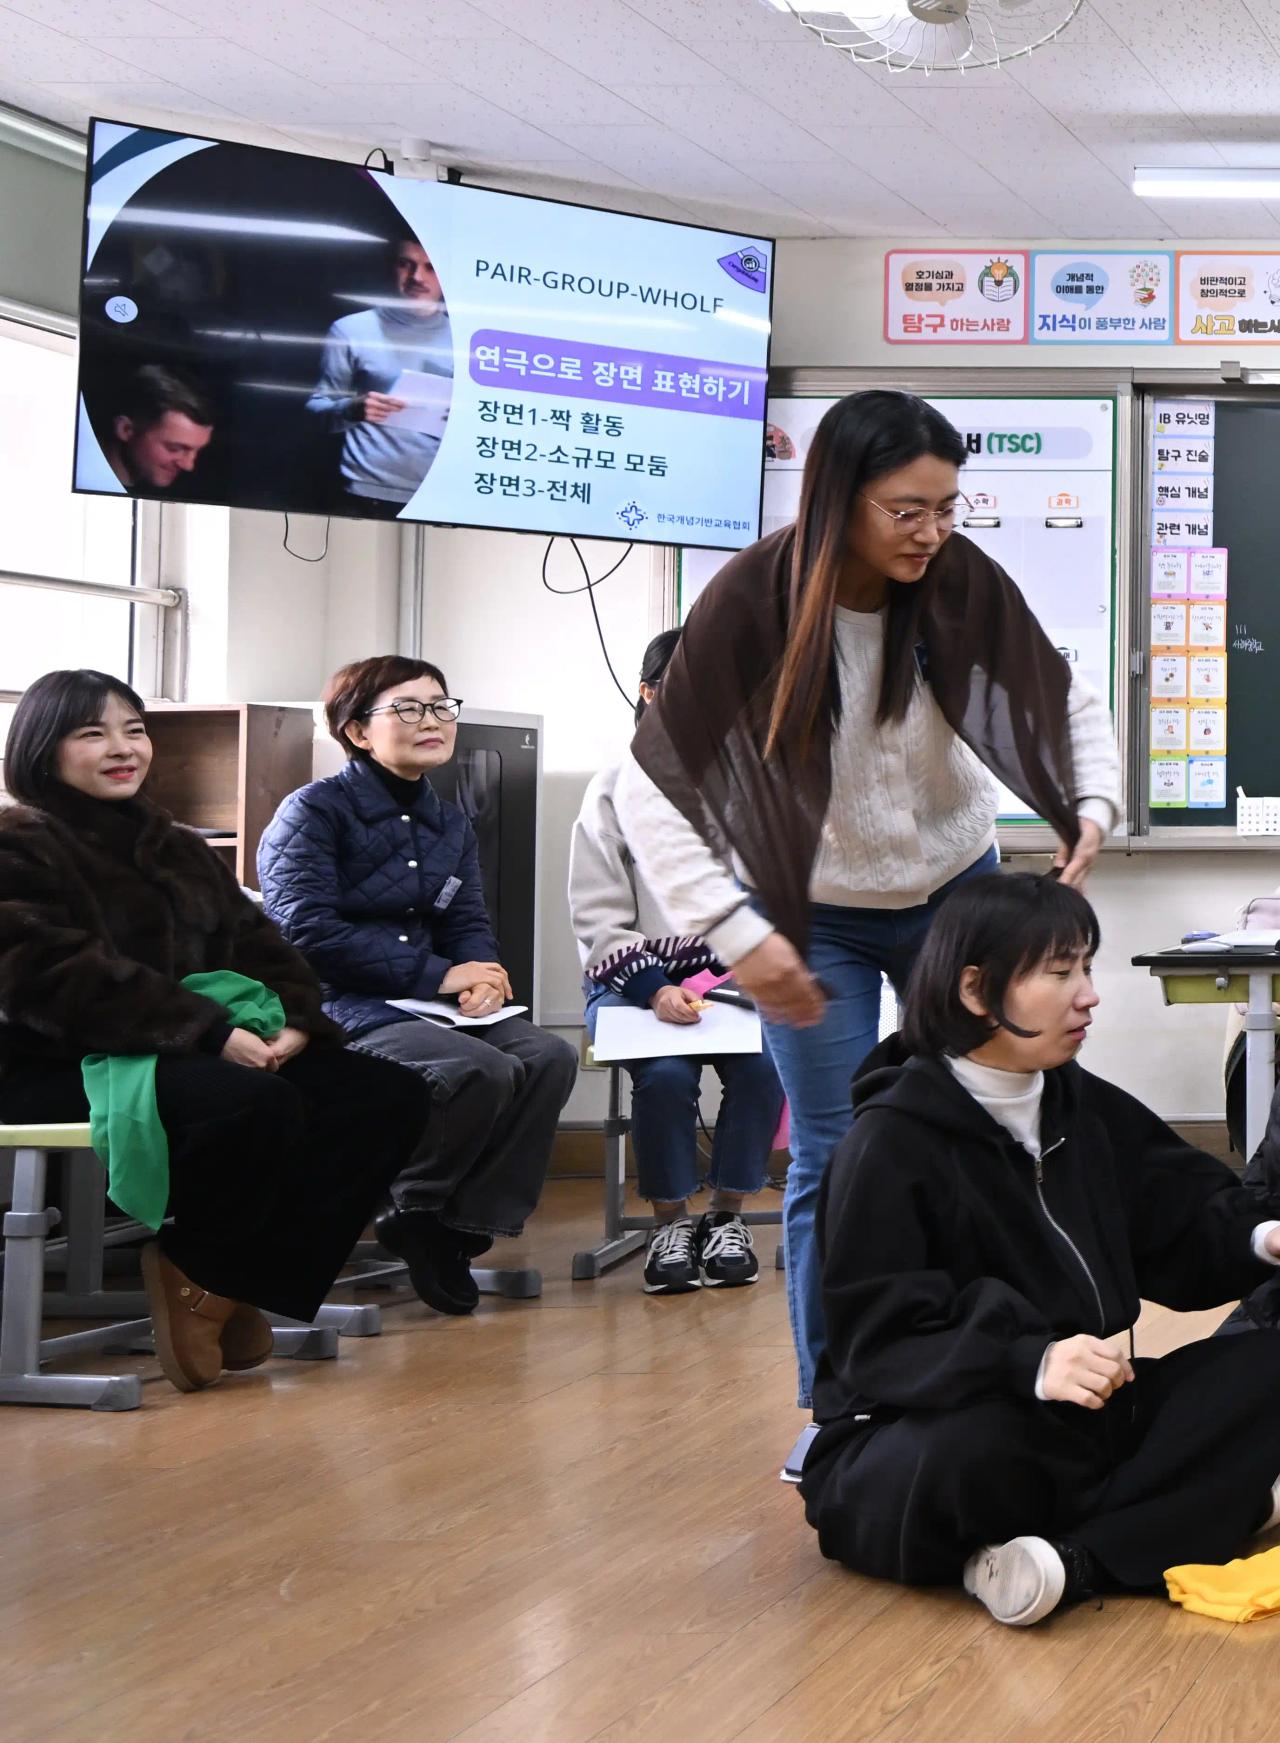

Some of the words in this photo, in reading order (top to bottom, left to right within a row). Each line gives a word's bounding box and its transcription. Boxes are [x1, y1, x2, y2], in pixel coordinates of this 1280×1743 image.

[915, 270, 954, 280] 호기심과
[1066, 273, 1094, 282] 개념적
[1200, 276, 1246, 286] 비판적이고
[904, 281, 932, 292] 열정을
[936, 281, 964, 292] 가지고
[1055, 284, 1083, 294] 이해를
[1086, 285, 1104, 294] 통한
[1200, 288, 1246, 298] 창의적으로
[902, 313, 945, 333] 탐구
[950, 317, 1011, 332] 하는사람
[1038, 313, 1091, 332] 지식이
[1095, 317, 1136, 331] 풍부한
[1141, 317, 1167, 331] 사람
[1191, 314, 1236, 335] 사고
[475, 345, 583, 381] 연극으로
[592, 360, 642, 391] 장면
[652, 369, 750, 405] 표현하기
[477, 400, 571, 432] 장면1-짝
[580, 411, 625, 438] 활동
[1159, 413, 1171, 424] IB
[1175, 413, 1210, 426] 유닛명
[987, 432, 1042, 454] (TSC)
[475, 436, 617, 470] 장면2-소규모
[624, 453, 668, 477] 모둠
[1157, 449, 1181, 462] 탐구
[1186, 450, 1209, 463] 진술
[473, 472, 592, 505] 장면3-전체
[1157, 486, 1181, 498] 핵심
[1185, 487, 1209, 499] 개념
[974, 498, 989, 506] 수학
[656, 513, 750, 531] 한국개념기반교육협회
[1157, 523, 1180, 536] 관련
[1185, 523, 1209, 536] 개념
